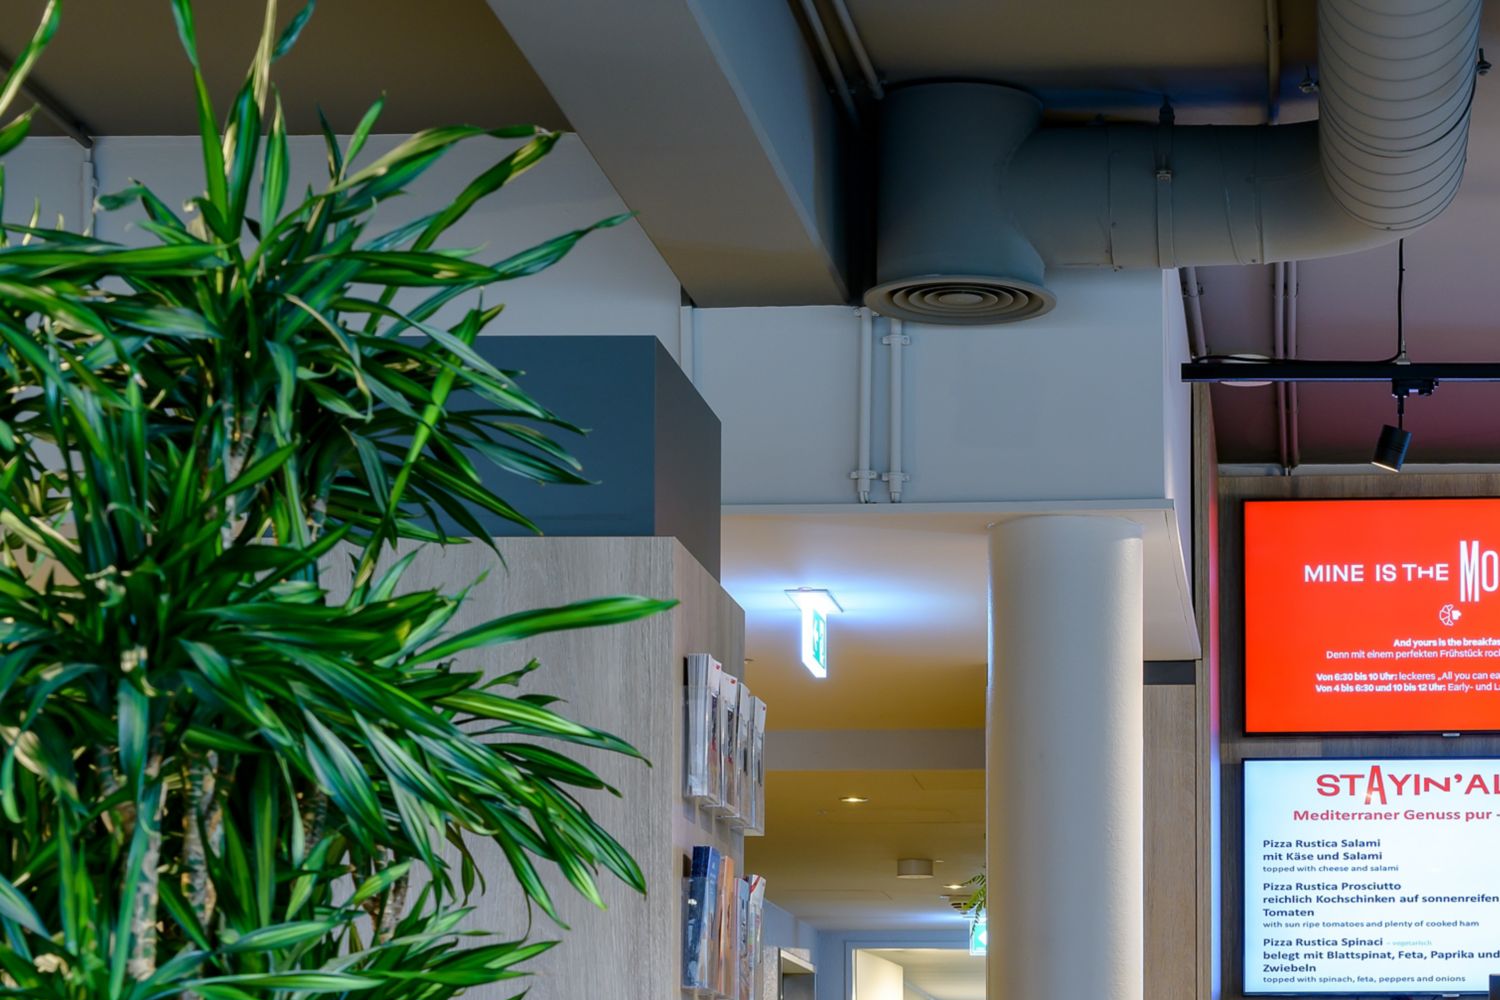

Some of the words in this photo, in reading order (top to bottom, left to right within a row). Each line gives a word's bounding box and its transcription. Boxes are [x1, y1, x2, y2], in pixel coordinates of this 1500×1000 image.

[1304, 564, 1365, 583] MINE
[1376, 563, 1397, 582] IS
[1402, 563, 1449, 582] THE
[1393, 639, 1412, 648] And
[1413, 640, 1438, 649] yours
[1438, 639, 1447, 647] is
[1448, 638, 1463, 647] the
[1326, 651, 1350, 660] Denn
[1351, 651, 1366, 659] mit
[1367, 651, 1394, 659] einem
[1396, 650, 1438, 660] perfekten
[1440, 649, 1483, 658] Frühstück
[1316, 673, 1333, 681] Von
[1354, 672, 1367, 681] bis
[1368, 673, 1379, 681] 10
[1399, 671, 1436, 681] leckeres
[1454, 673, 1470, 682] you
[1315, 684, 1333, 693] Von
[1334, 684, 1340, 692] 4
[1341, 684, 1354, 692] bis
[1375, 684, 1392, 692] und
[1393, 684, 1402, 692] 10
[1403, 683, 1417, 691] bis
[1418, 684, 1427, 692] 12
[1476, 682, 1493, 691] und
[1293, 809, 1400, 821] Mediterraner
[1403, 809, 1461, 821] Genuss
[1465, 809, 1492, 822] pur
[1263, 839, 1293, 848] Pizza
[1295, 839, 1338, 848] Rustica
[1341, 838, 1381, 848] Salami
[1263, 852, 1283, 861] mit
[1286, 851, 1314, 861] Käse
[1317, 851, 1339, 861] und
[1343, 851, 1383, 860] Salami
[1263, 865, 1295, 873] topped
[1296, 864, 1317, 872] with
[1318, 864, 1349, 872] cheese
[1350, 864, 1369, 872] and
[1370, 864, 1399, 872] salami
[1263, 882, 1293, 891] Pizza
[1295, 882, 1338, 891] Rustica
[1341, 881, 1402, 891] Prosciutto
[1263, 895, 1312, 904] reichlich
[1316, 894, 1396, 903] Kochschinken
[1399, 893, 1419, 903] auf
[1422, 893, 1500, 903] sonnenreifen
[1263, 908, 1315, 917] Tomaten
[1365, 920, 1383, 928] and
[1384, 920, 1413, 928] plenty
[1263, 938, 1293, 947] Pizza
[1295, 938, 1338, 947] Rustica
[1341, 937, 1383, 948] Spinaci
[1263, 951, 1300, 961] belegt
[1303, 951, 1323, 960] mit
[1327, 950, 1395, 961] Blattspinat,
[1398, 950, 1427, 960] Feta,
[1430, 950, 1475, 960] Paprika
[1478, 950, 1500, 959] und
[1263, 963, 1317, 973] Zwiebeln
[1263, 976, 1295, 984] topped
[1318, 976, 1356, 984] spinach,
